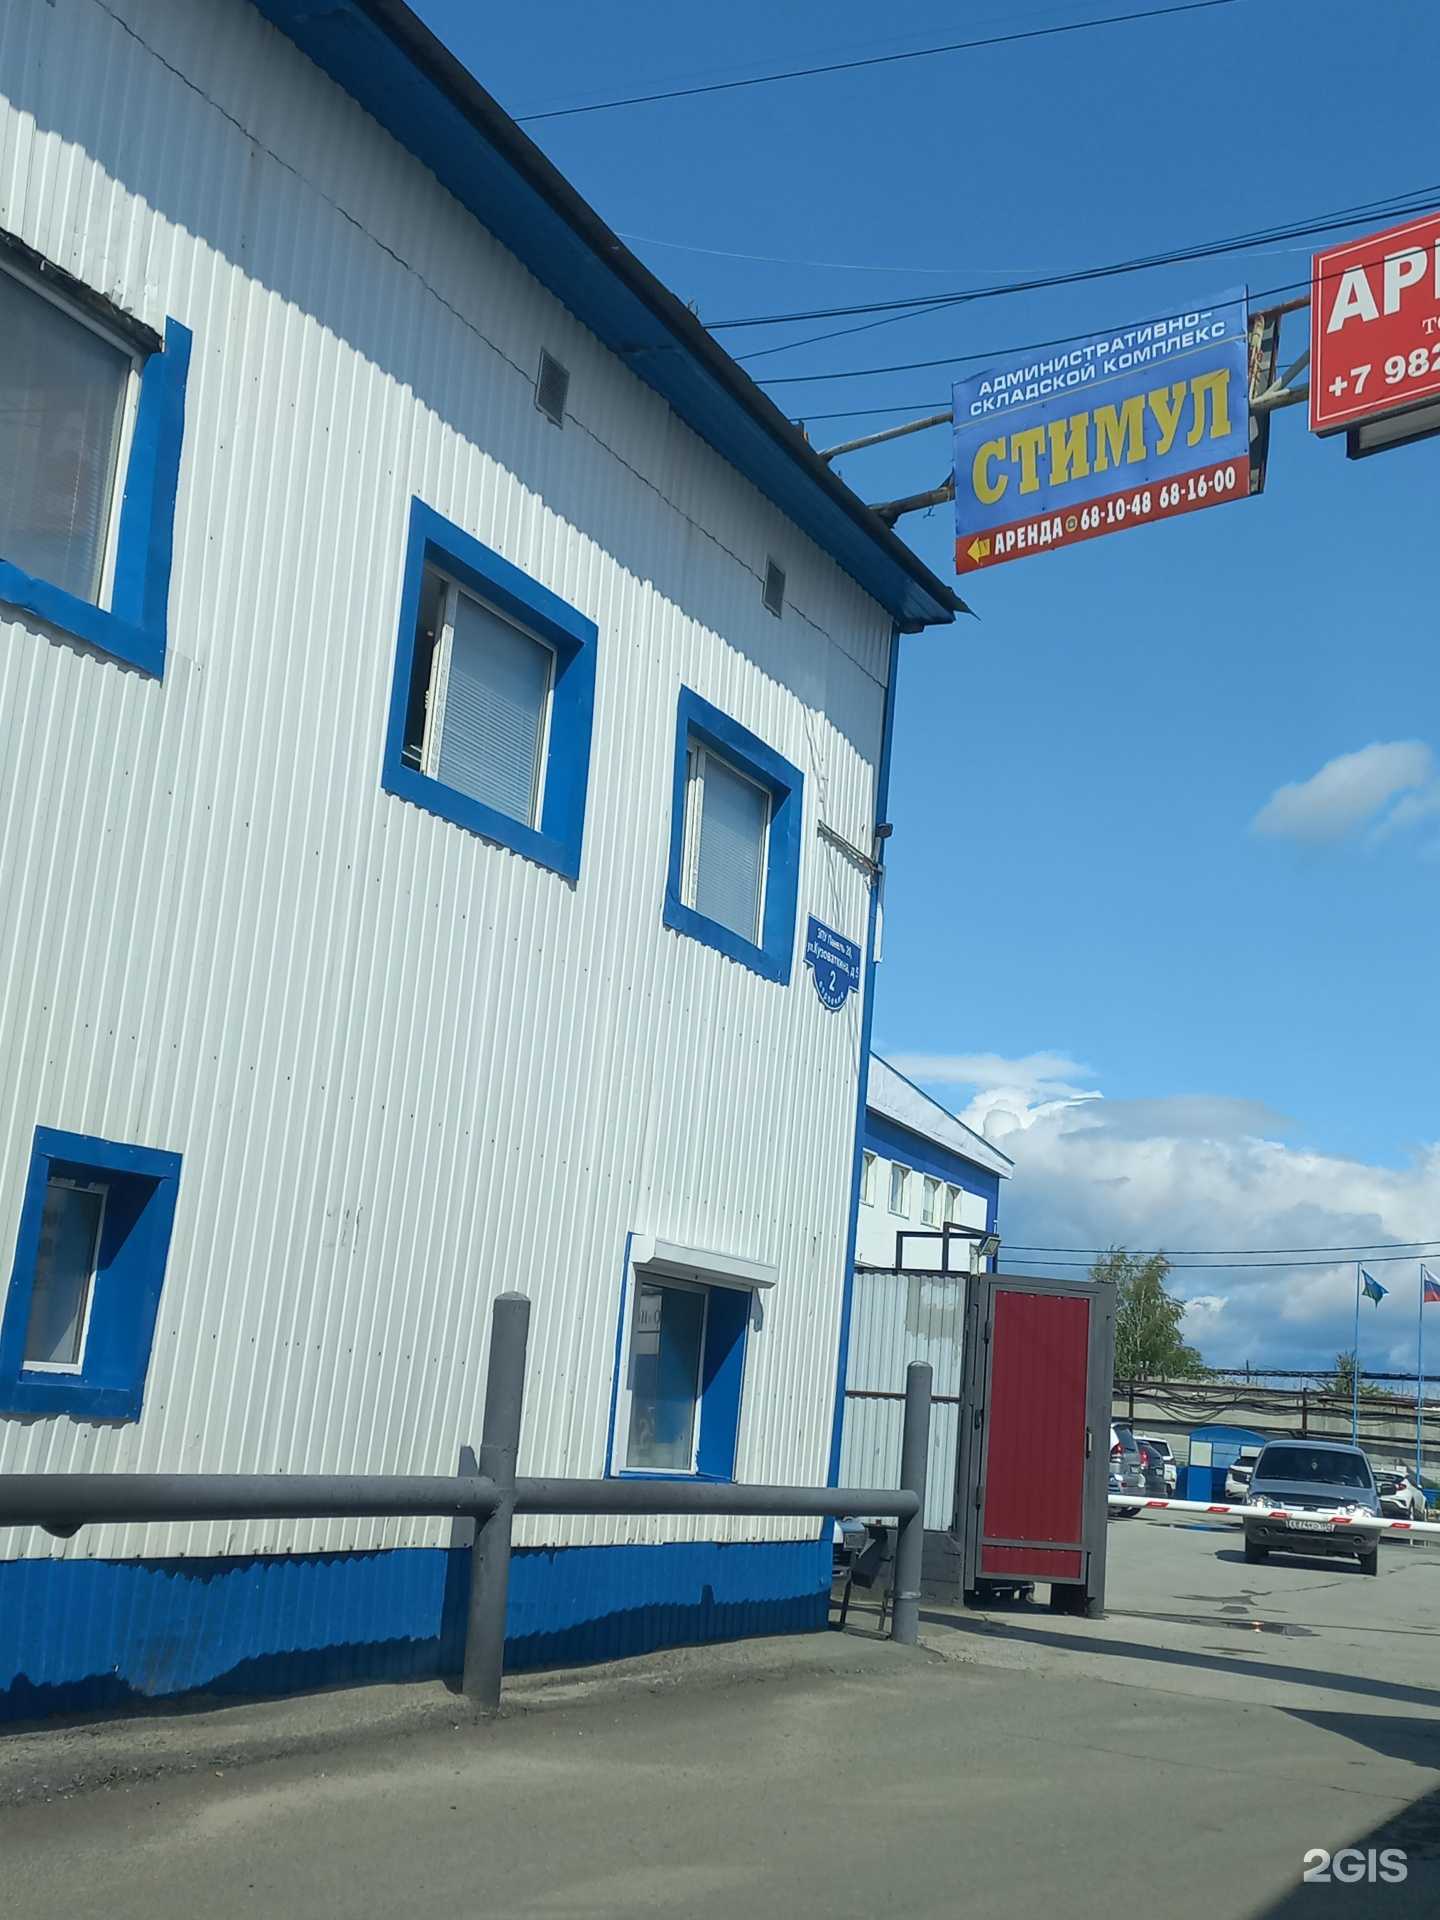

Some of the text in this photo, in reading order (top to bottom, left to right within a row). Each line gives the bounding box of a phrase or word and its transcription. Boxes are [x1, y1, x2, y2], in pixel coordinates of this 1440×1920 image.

[1326, 238, 1440, 334] АР
[970, 322, 1226, 417] СКЛАДСКОЙ КОМПЛЕКС
[978, 311, 1212, 396] АДМИНИСТРАТИВНО-
[1328, 364, 1372, 397] +7
[972, 368, 1232, 505] СТИМУЛ
[994, 465, 1236, 555] АРЕНДА 68-10-48 68-16-00
[828, 970, 837, 992] 2
